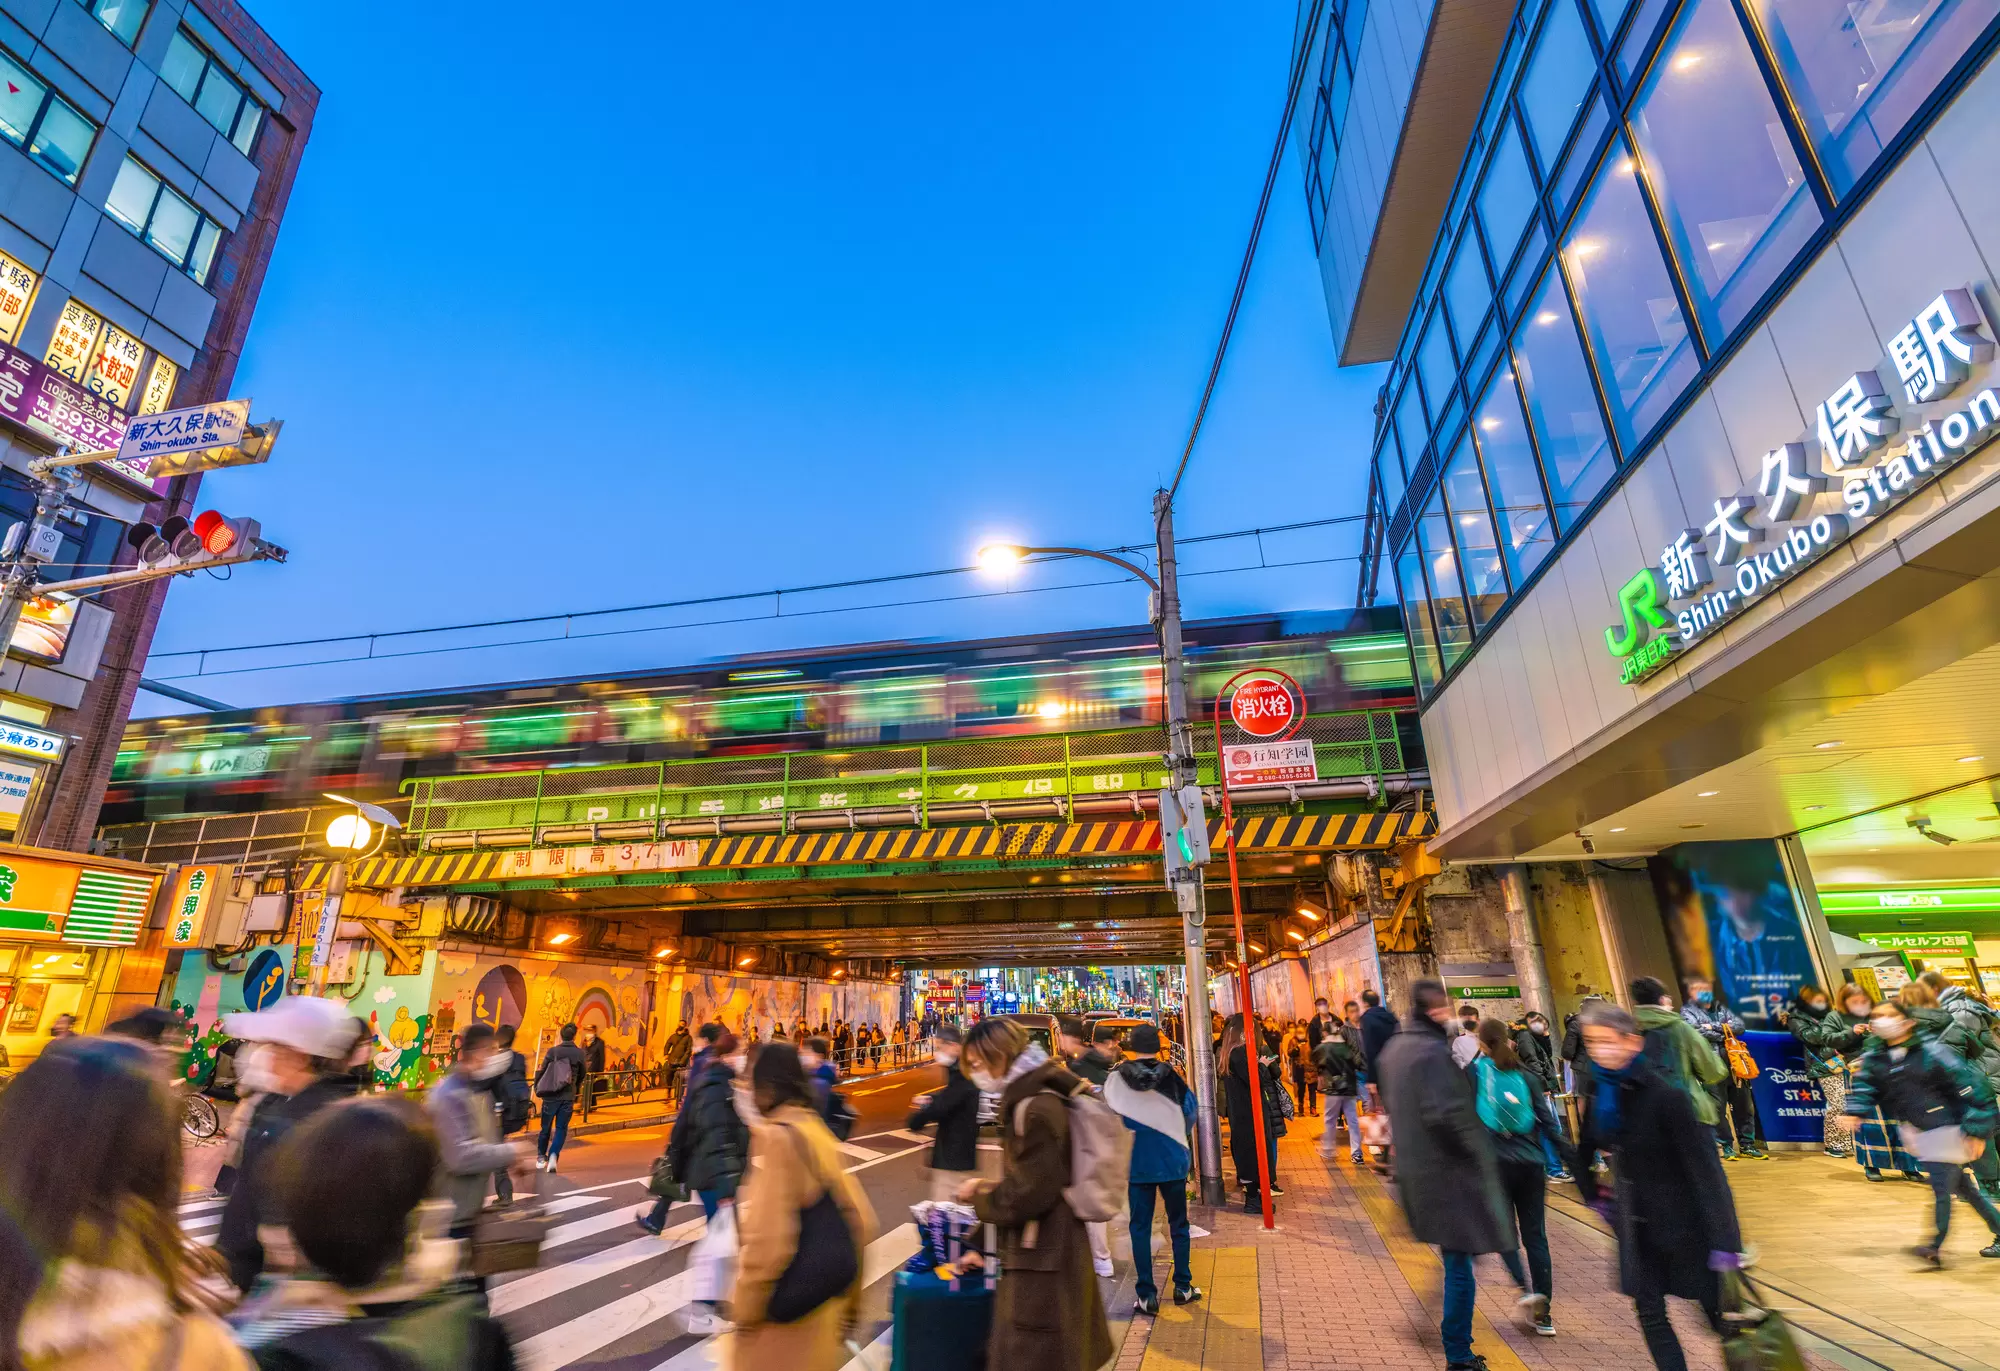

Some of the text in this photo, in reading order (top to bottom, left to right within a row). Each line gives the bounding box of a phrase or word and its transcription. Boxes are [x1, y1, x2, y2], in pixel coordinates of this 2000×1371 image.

[54, 337, 83, 364] 社会人
[64, 304, 139, 362] 受験 資格
[59, 324, 134, 389] 新卒者 大歓迎
[89, 377, 119, 405] 36
[139, 431, 220, 452] Shin-okubo Sta.
[1660, 292, 1973, 600] 新大久保駅
[1677, 387, 2000, 640] Shin-Ōkubo Station
[1604, 567, 1666, 657] JR
[1619, 633, 1671, 685] JR東日本
[1236, 695, 1289, 720] 消火栓
[1253, 746, 1309, 762] 行知学园
[0, 786, 27, 798] 力施設
[174, 869, 206, 942] 吉野家
[1865, 935, 1968, 947] オールセルフ店舗
